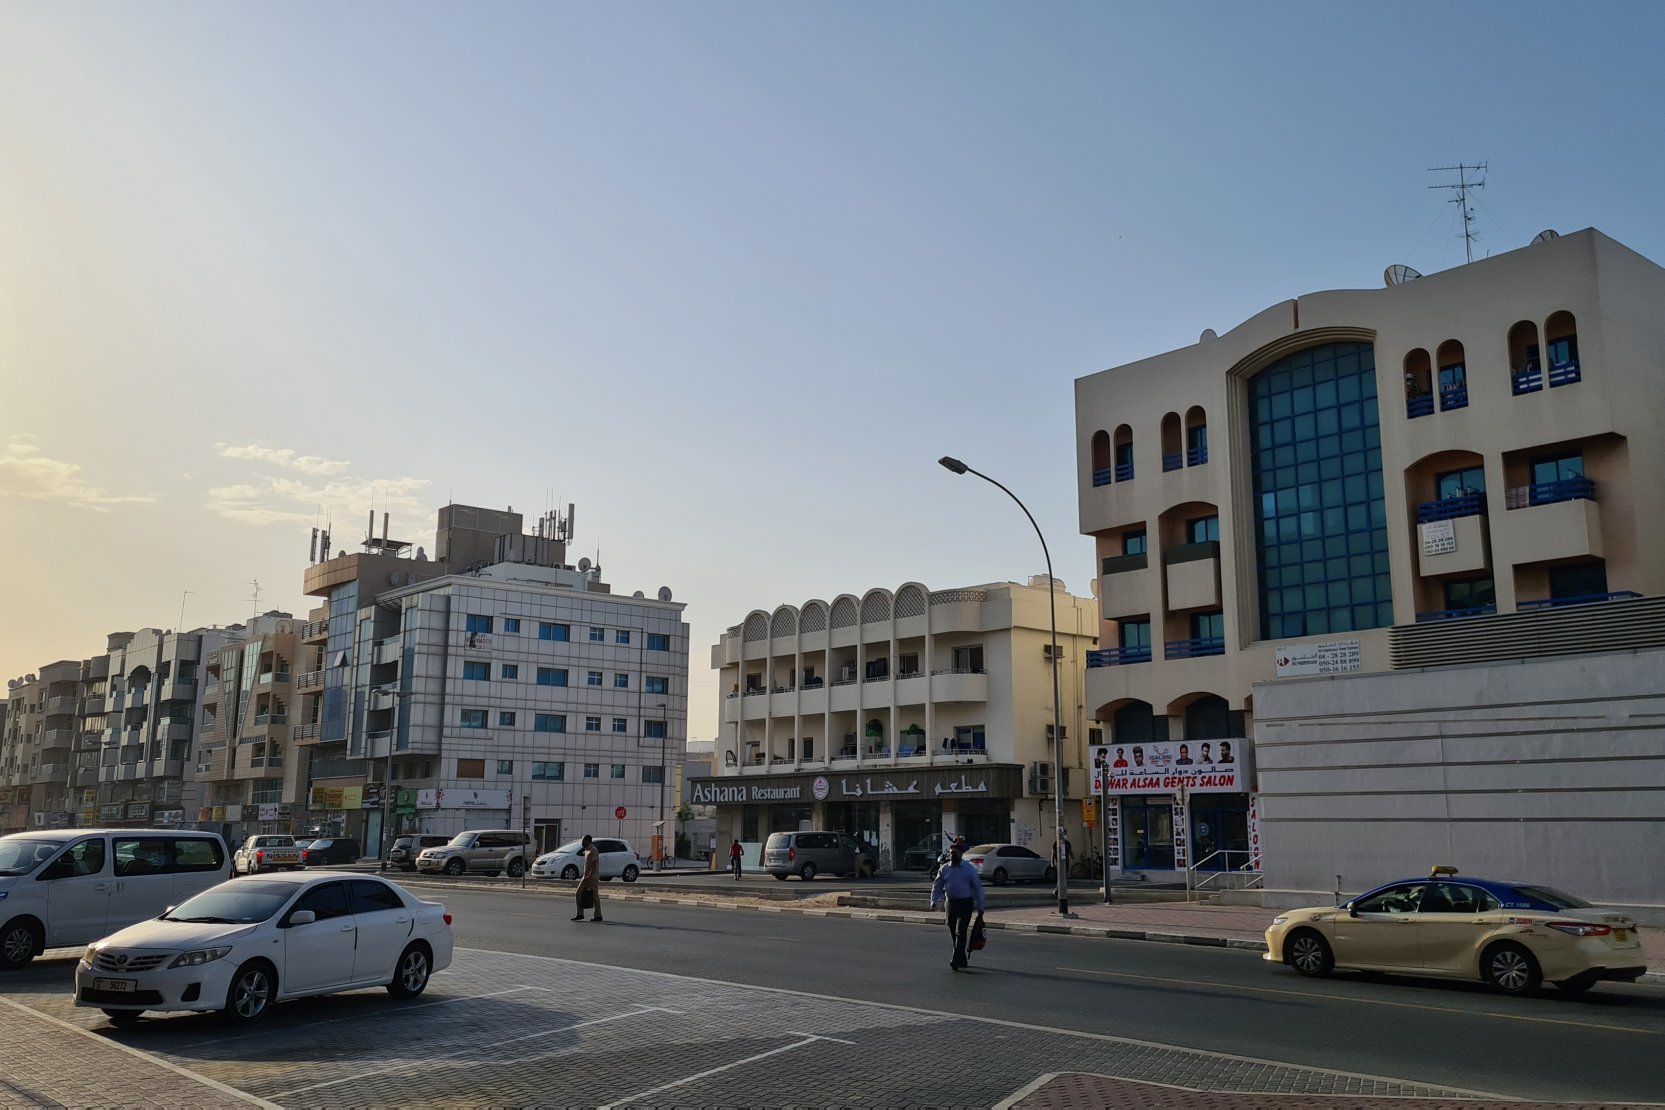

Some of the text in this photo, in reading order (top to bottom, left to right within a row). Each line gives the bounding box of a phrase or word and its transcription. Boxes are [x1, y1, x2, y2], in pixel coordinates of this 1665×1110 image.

[1129, 767, 1169, 775] الساعة
[1191, 766, 1234, 775] صالون
[841, 774, 987, 797] مطعم عشانا
[1094, 774, 1234, 790] DWAR ALSAA GENTS SALON
[693, 783, 801, 802] Ashana Restaurant
